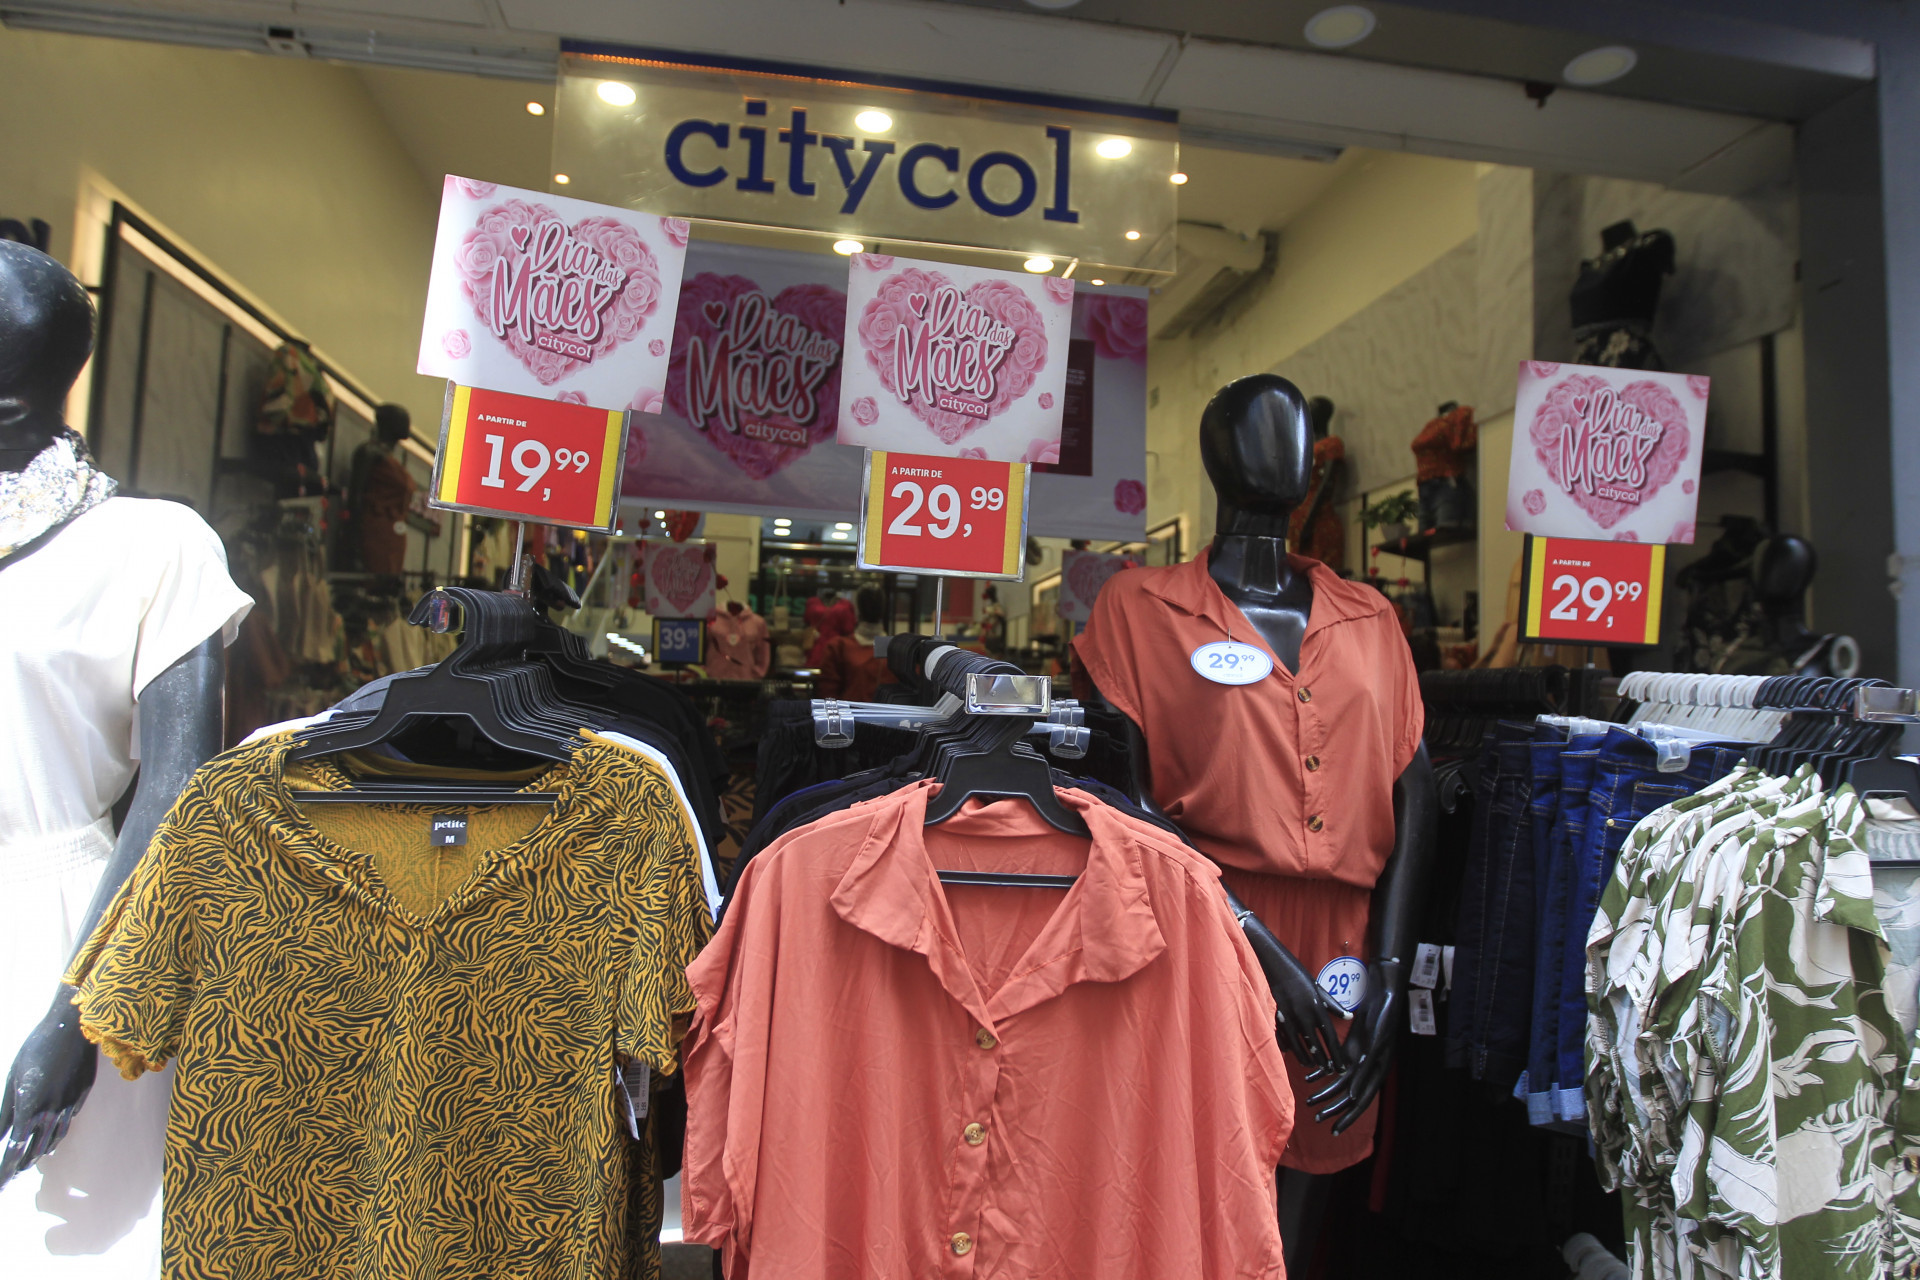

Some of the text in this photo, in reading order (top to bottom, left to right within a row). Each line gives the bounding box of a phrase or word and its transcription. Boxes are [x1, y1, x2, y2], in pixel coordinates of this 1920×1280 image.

[664, 99, 1079, 223] citycol
[529, 219, 626, 289] Dia das
[492, 255, 611, 341] Mães
[729, 292, 837, 362] Dia das
[927, 286, 1014, 347] Dia das
[538, 334, 593, 358] citycol
[896, 322, 1003, 402] Mães
[689, 332, 824, 431] Mães
[477, 413, 528, 428] A PARTIR DE
[939, 397, 989, 416] citycol
[1588, 388, 1642, 436] Dia
[744, 421, 808, 444] citycol
[891, 466, 943, 479] A PARTIR DE
[1561, 420, 1652, 493] Mães
[1598, 486, 1640, 502] citycol
[1552, 558, 1592, 568] A PARTIR DE
[434, 819, 467, 831] petite
[444, 835, 456, 844] M
